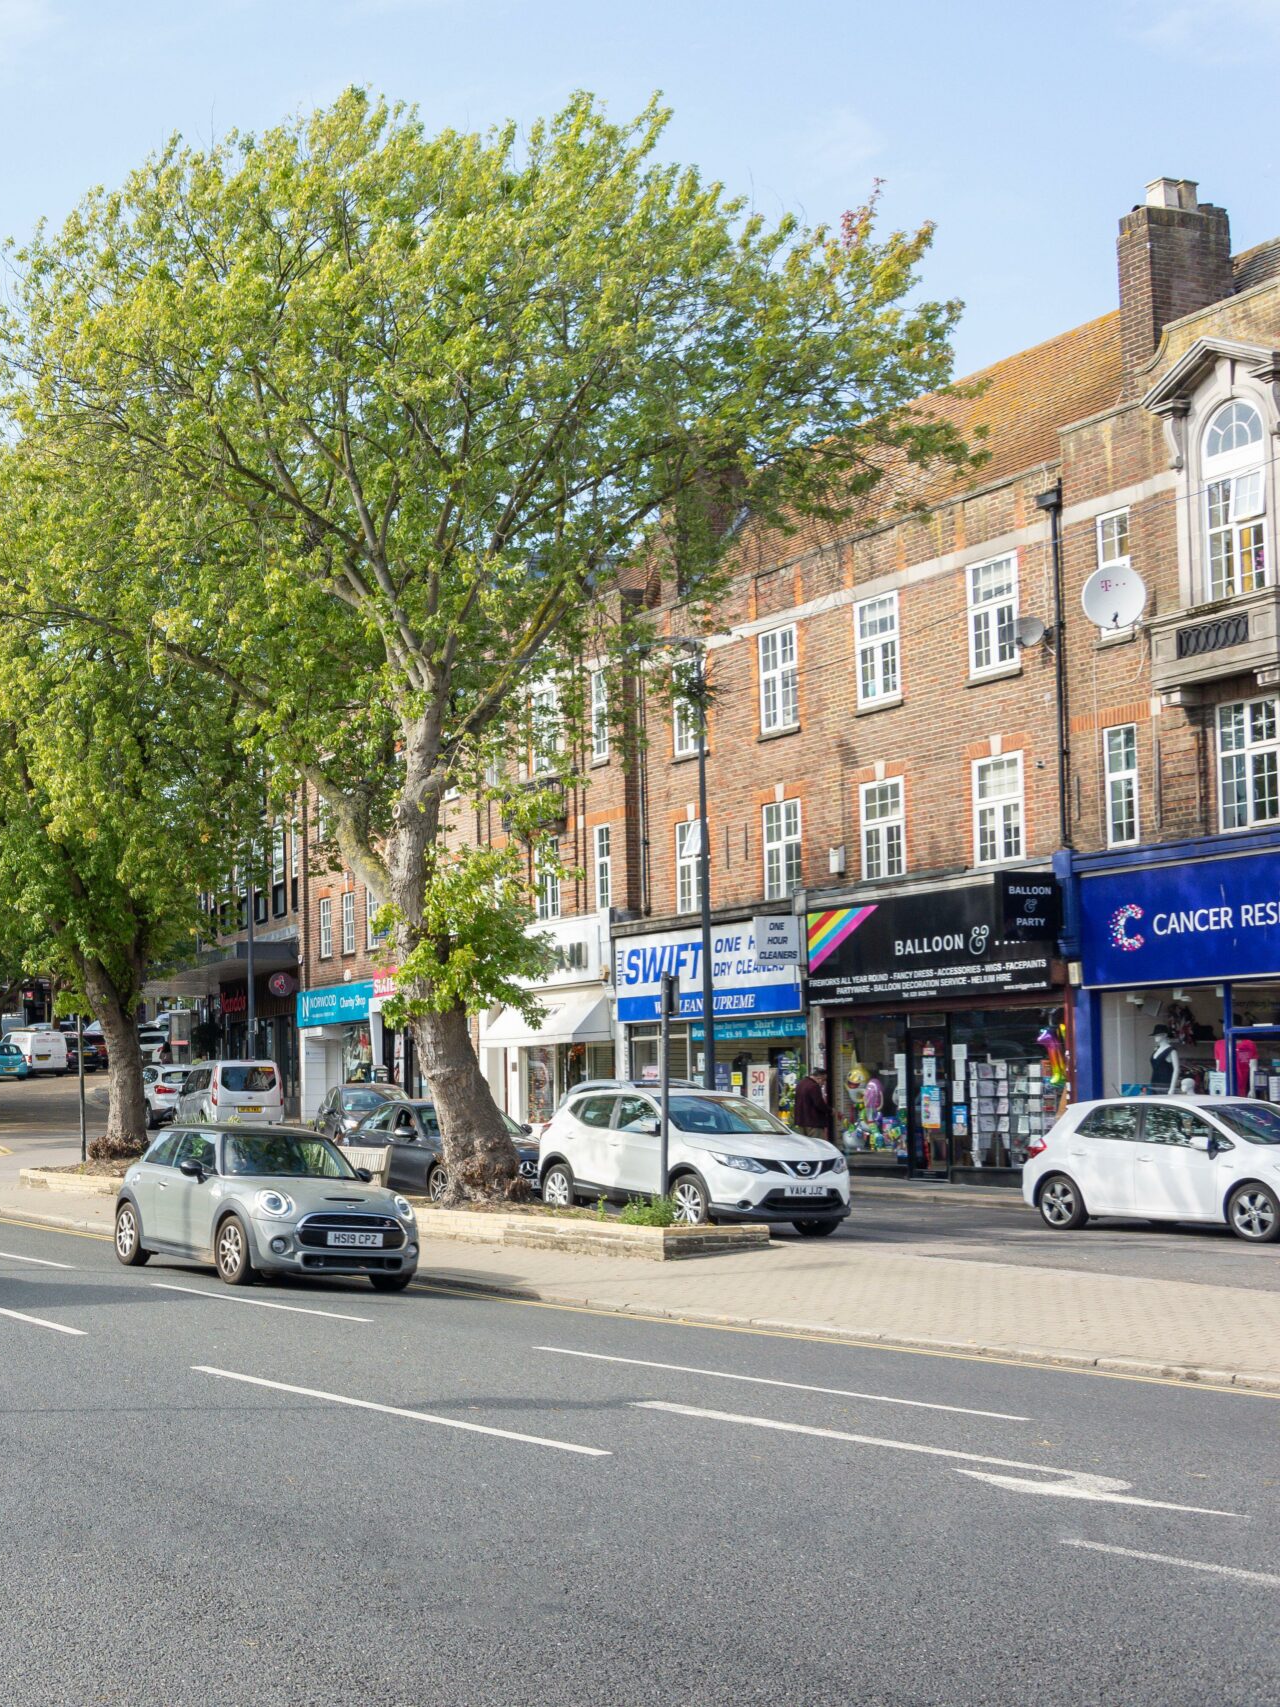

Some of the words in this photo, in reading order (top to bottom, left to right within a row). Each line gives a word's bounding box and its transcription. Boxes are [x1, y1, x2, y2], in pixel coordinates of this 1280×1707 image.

[1008, 886, 1052, 895] BALLOON
[1024, 898, 1038, 913] &
[1016, 918, 1046, 926] PARTY
[1152, 906, 1233, 936] CANCER
[1240, 901, 1280, 927] RES
[769, 922, 785, 931] ONE
[714, 935, 742, 954] ONE
[767, 936, 788, 945] HOUR
[894, 934, 964, 956] BALLOON
[969, 925, 990, 955] &
[759, 951, 798, 960] CLEANERS
[624, 941, 703, 985] SWIFT
[713, 962, 733, 977] DRY
[809, 977, 841, 988] FIREWORKS
[852, 975, 868, 984] YEAR
[868, 973, 889, 982] ROUND
[893, 971, 913, 980] FANCY
[914, 969, 934, 978] DRESS
[937, 965, 981, 976] ACCESSORIES
[985, 963, 1002, 972] WIGS
[1005, 959, 1047, 971] FACEPAINTS
[836, 985, 870, 995] PARTYWARE
[874, 982, 901, 992] BALLOON
[902, 979, 940, 990] DECORATION
[940, 977, 967, 986] SERVICE
[971, 974, 995, 984] HELIUM
[995, 973, 1012, 982] HIRE
[310, 994, 337, 1009] NORWOOD
[340, 997, 355, 1010] Charity
[355, 994, 366, 1009] Shop
[679, 999, 703, 1012] LEAN
[712, 994, 756, 1009] UPREME
[754, 1020, 774, 1029] Shirt
[751, 1071, 765, 1084] 50
[752, 1086, 765, 1097] off
[790, 1186, 807, 1195] VA14
[334, 1233, 356, 1244] HS19
[359, 1234, 378, 1245] CPZ
